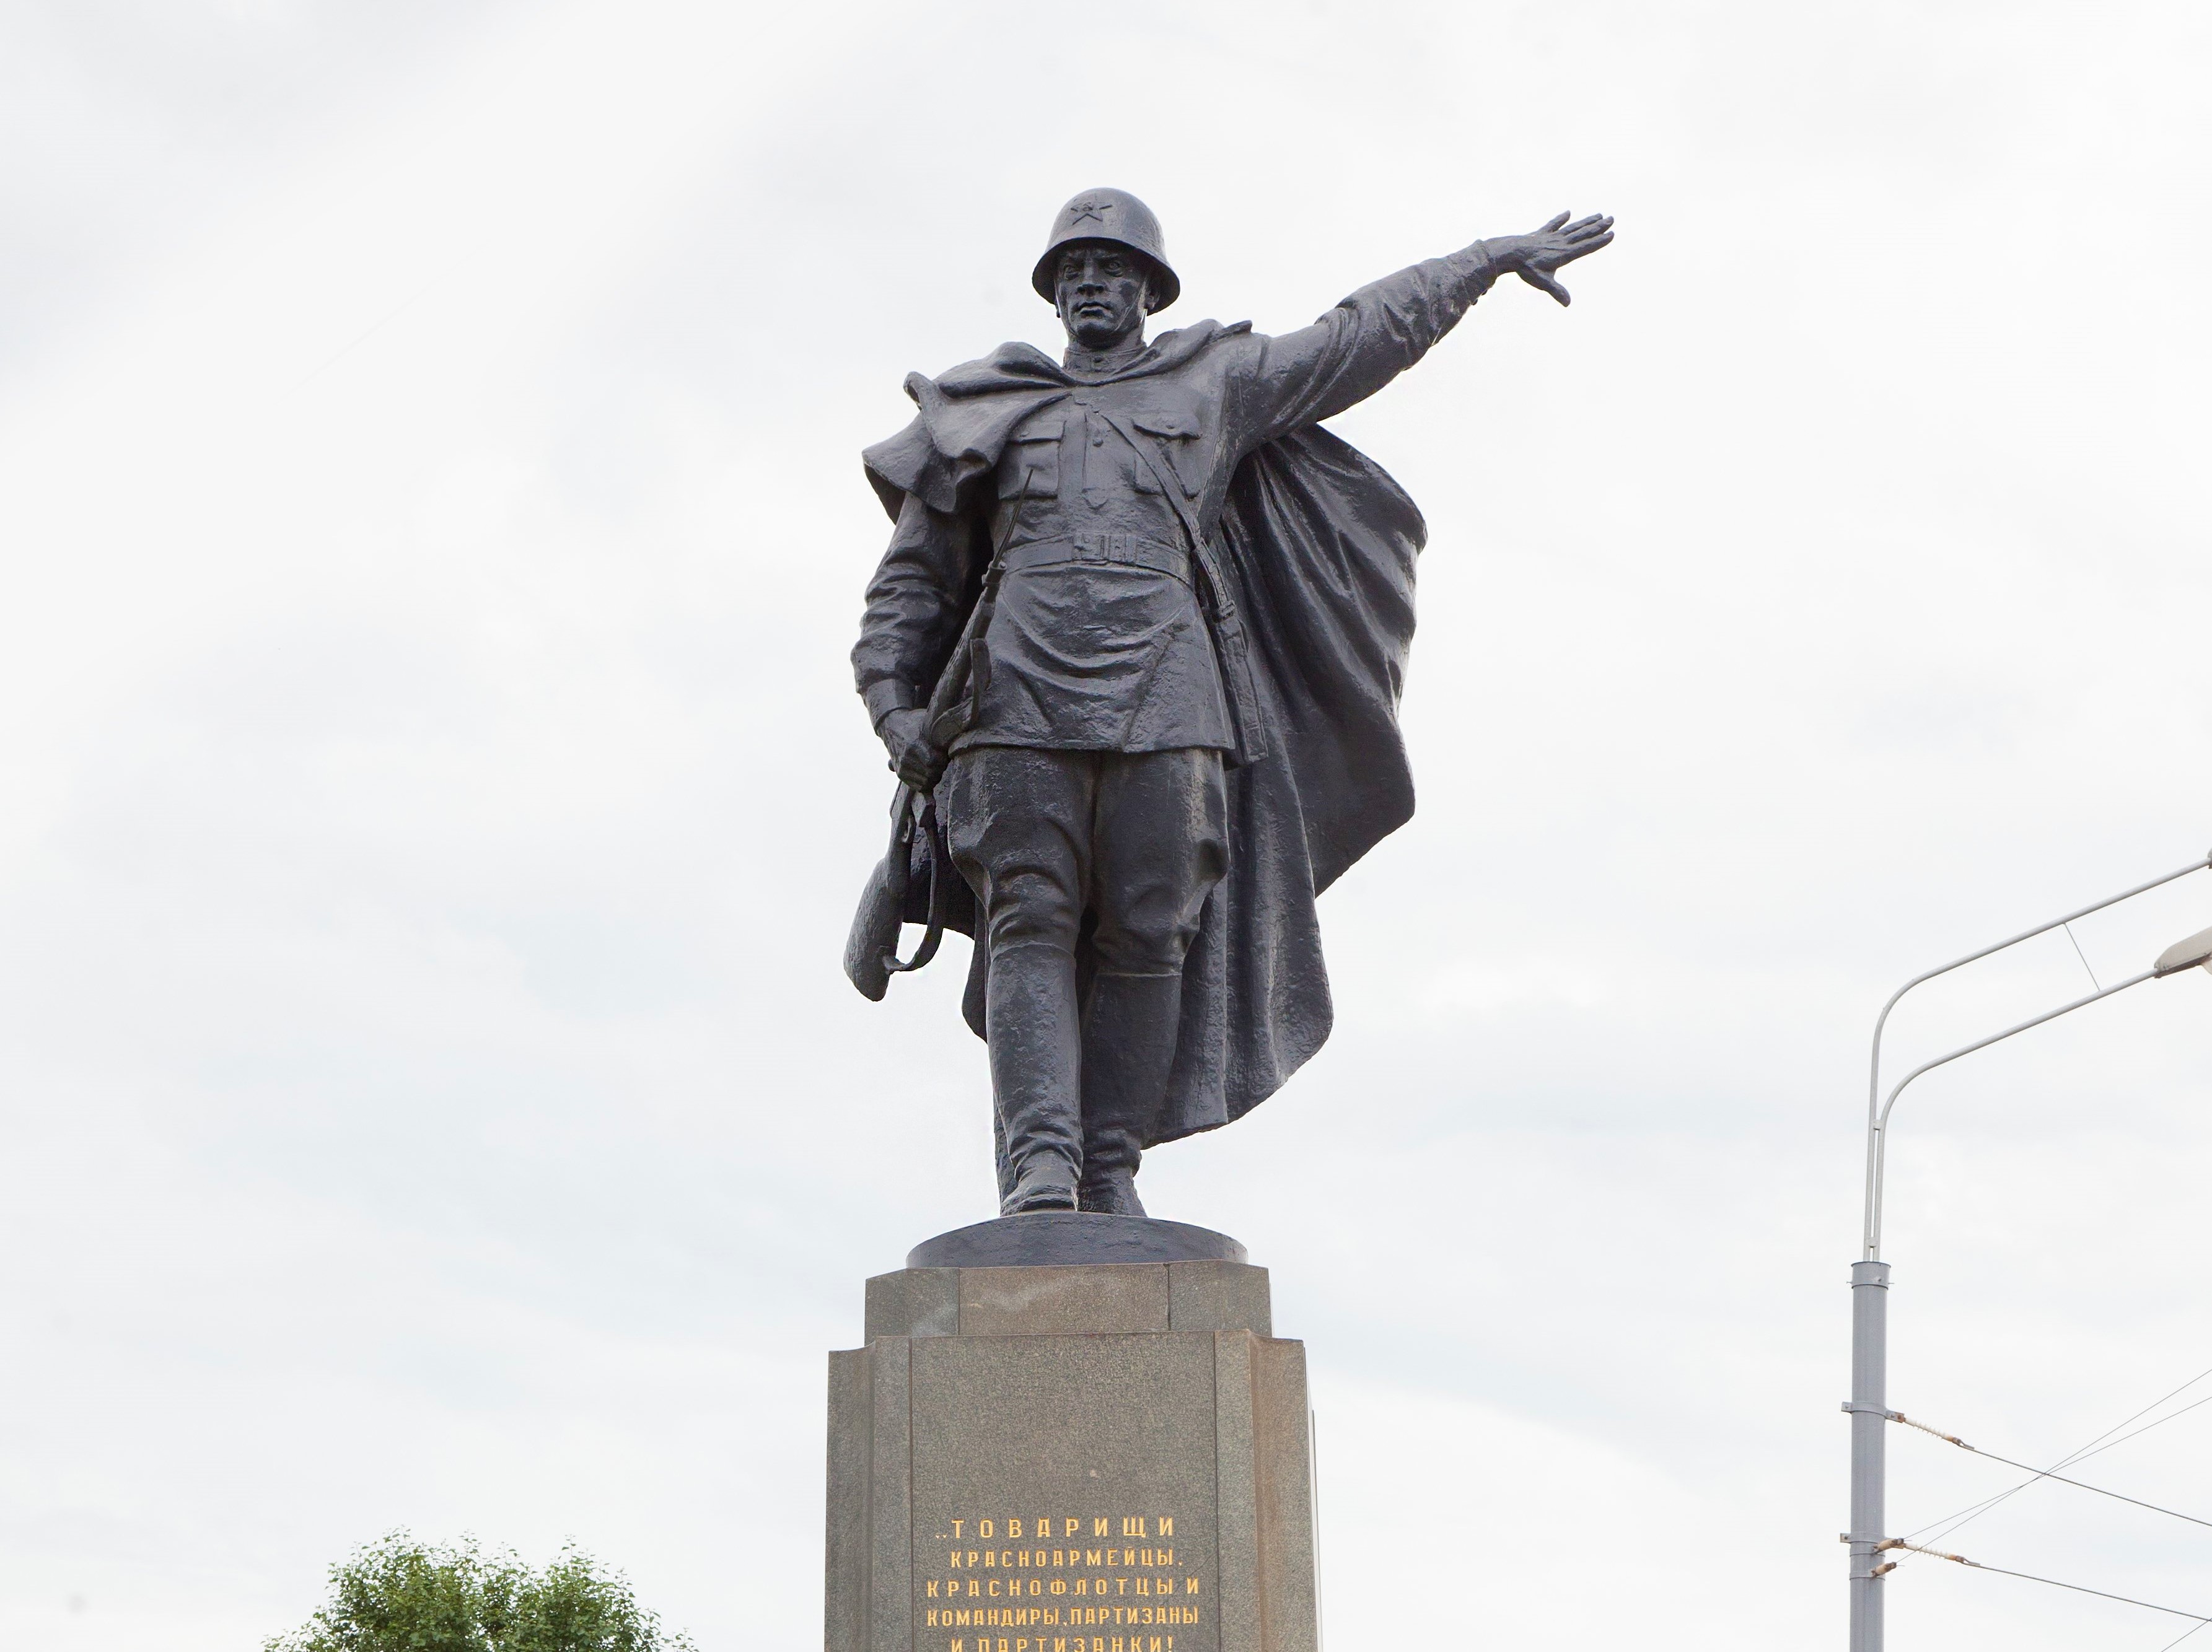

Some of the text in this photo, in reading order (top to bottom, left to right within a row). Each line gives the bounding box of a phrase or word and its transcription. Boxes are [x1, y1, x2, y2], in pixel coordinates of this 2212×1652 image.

[927, 1576, 1200, 1597] КРАСНОФЛОТЦЫ И
[951, 1635, 1174, 1652] И ПАРТИЗАНКИ!
